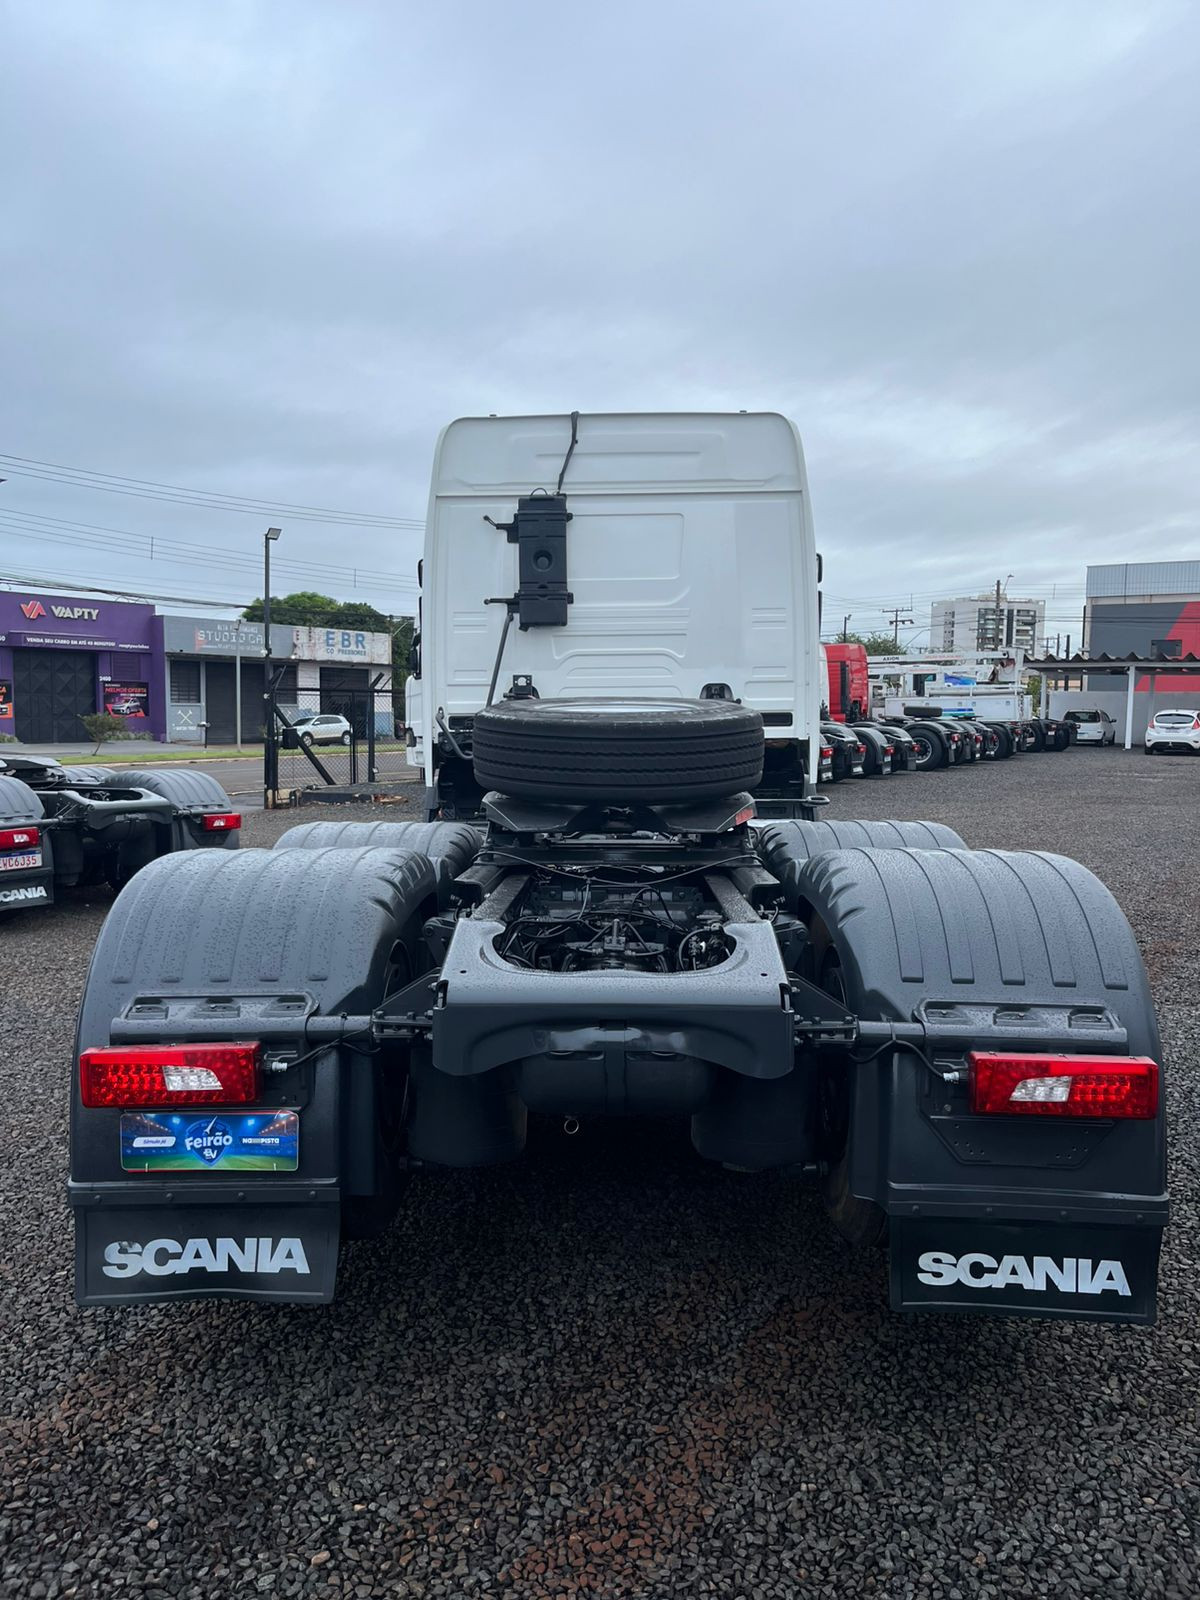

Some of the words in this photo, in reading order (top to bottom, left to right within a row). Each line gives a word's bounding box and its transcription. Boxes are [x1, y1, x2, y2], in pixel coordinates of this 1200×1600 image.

[50, 605, 99, 620] VAPTY
[198, 630, 246, 643] STUDIO
[248, 634, 272, 645] CA
[326, 630, 366, 649] EBR
[0, 886, 47, 903] CANIA
[184, 1132, 233, 1151] Feirão
[102, 1237, 310, 1279] SCANIA
[917, 1251, 1131, 1296] SCANIA
